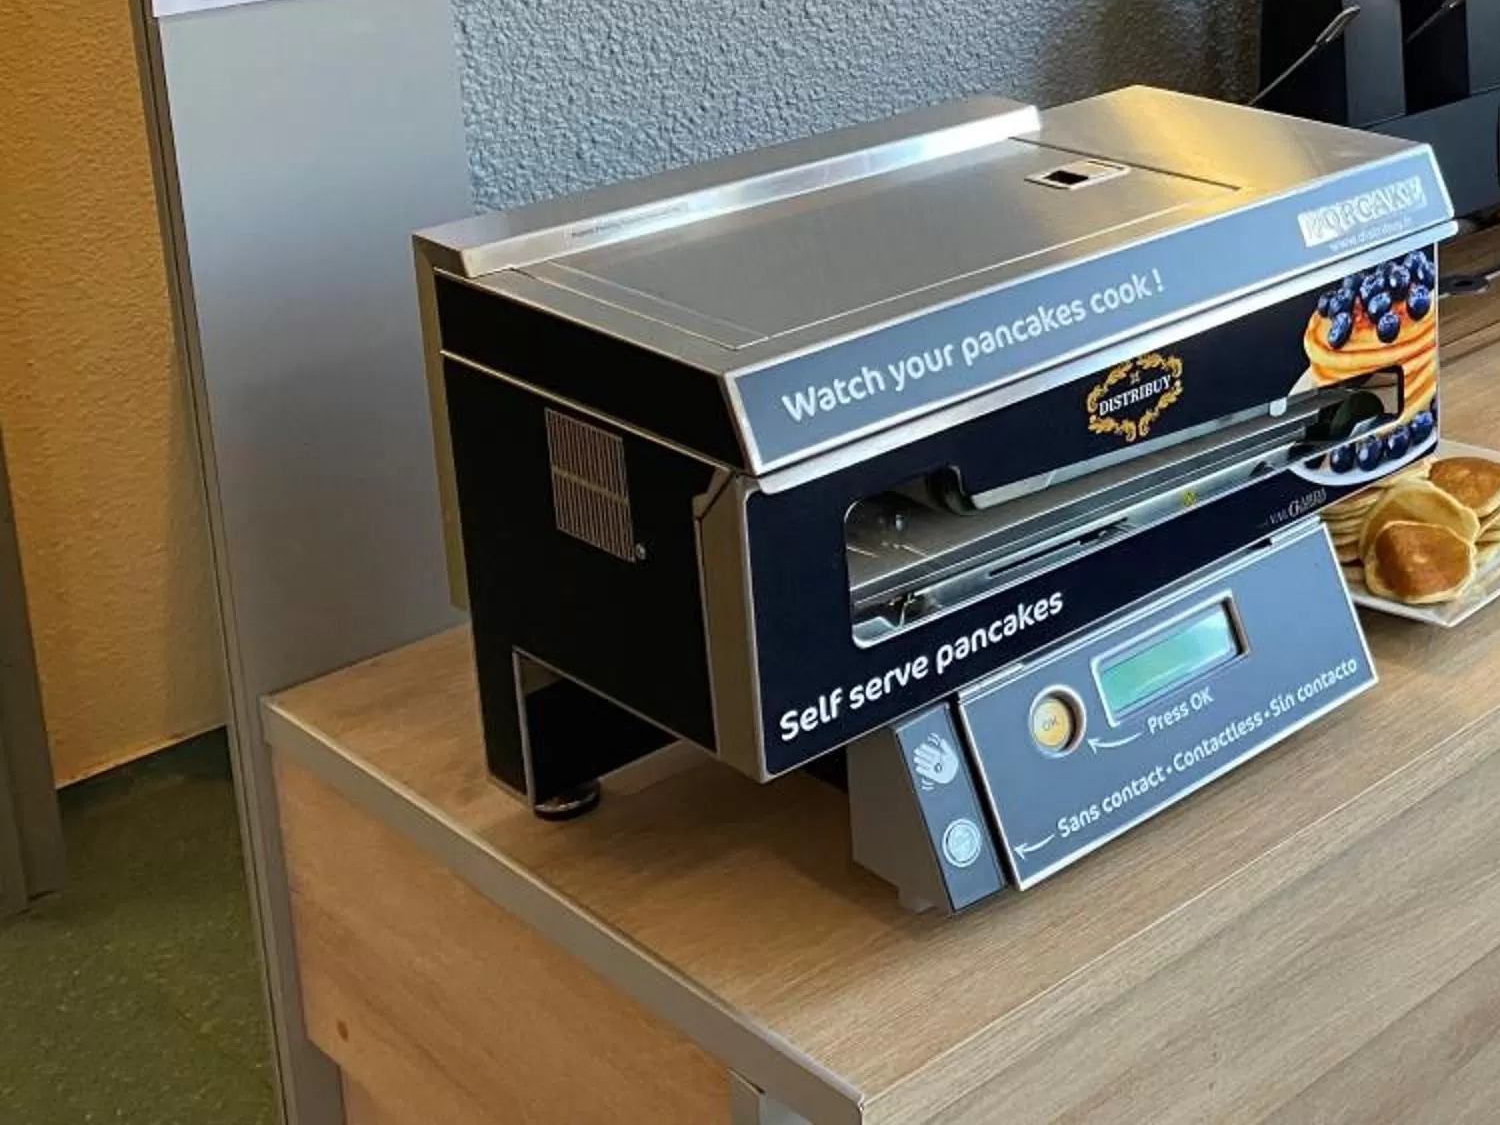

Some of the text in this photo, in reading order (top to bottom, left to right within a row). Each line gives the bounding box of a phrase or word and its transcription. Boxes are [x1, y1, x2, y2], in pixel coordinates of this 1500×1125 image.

[781, 365, 886, 423] Watch
[889, 342, 955, 393] your
[961, 297, 1087, 367] pancakes
[1089, 272, 1150, 315] cook
[1098, 373, 1172, 417] DISTRIBUY
[779, 591, 1065, 741] Self serve pancakes
[1146, 687, 1215, 736] Press OK
[1057, 657, 1358, 839] Sans contact Contactless Sin contacto
